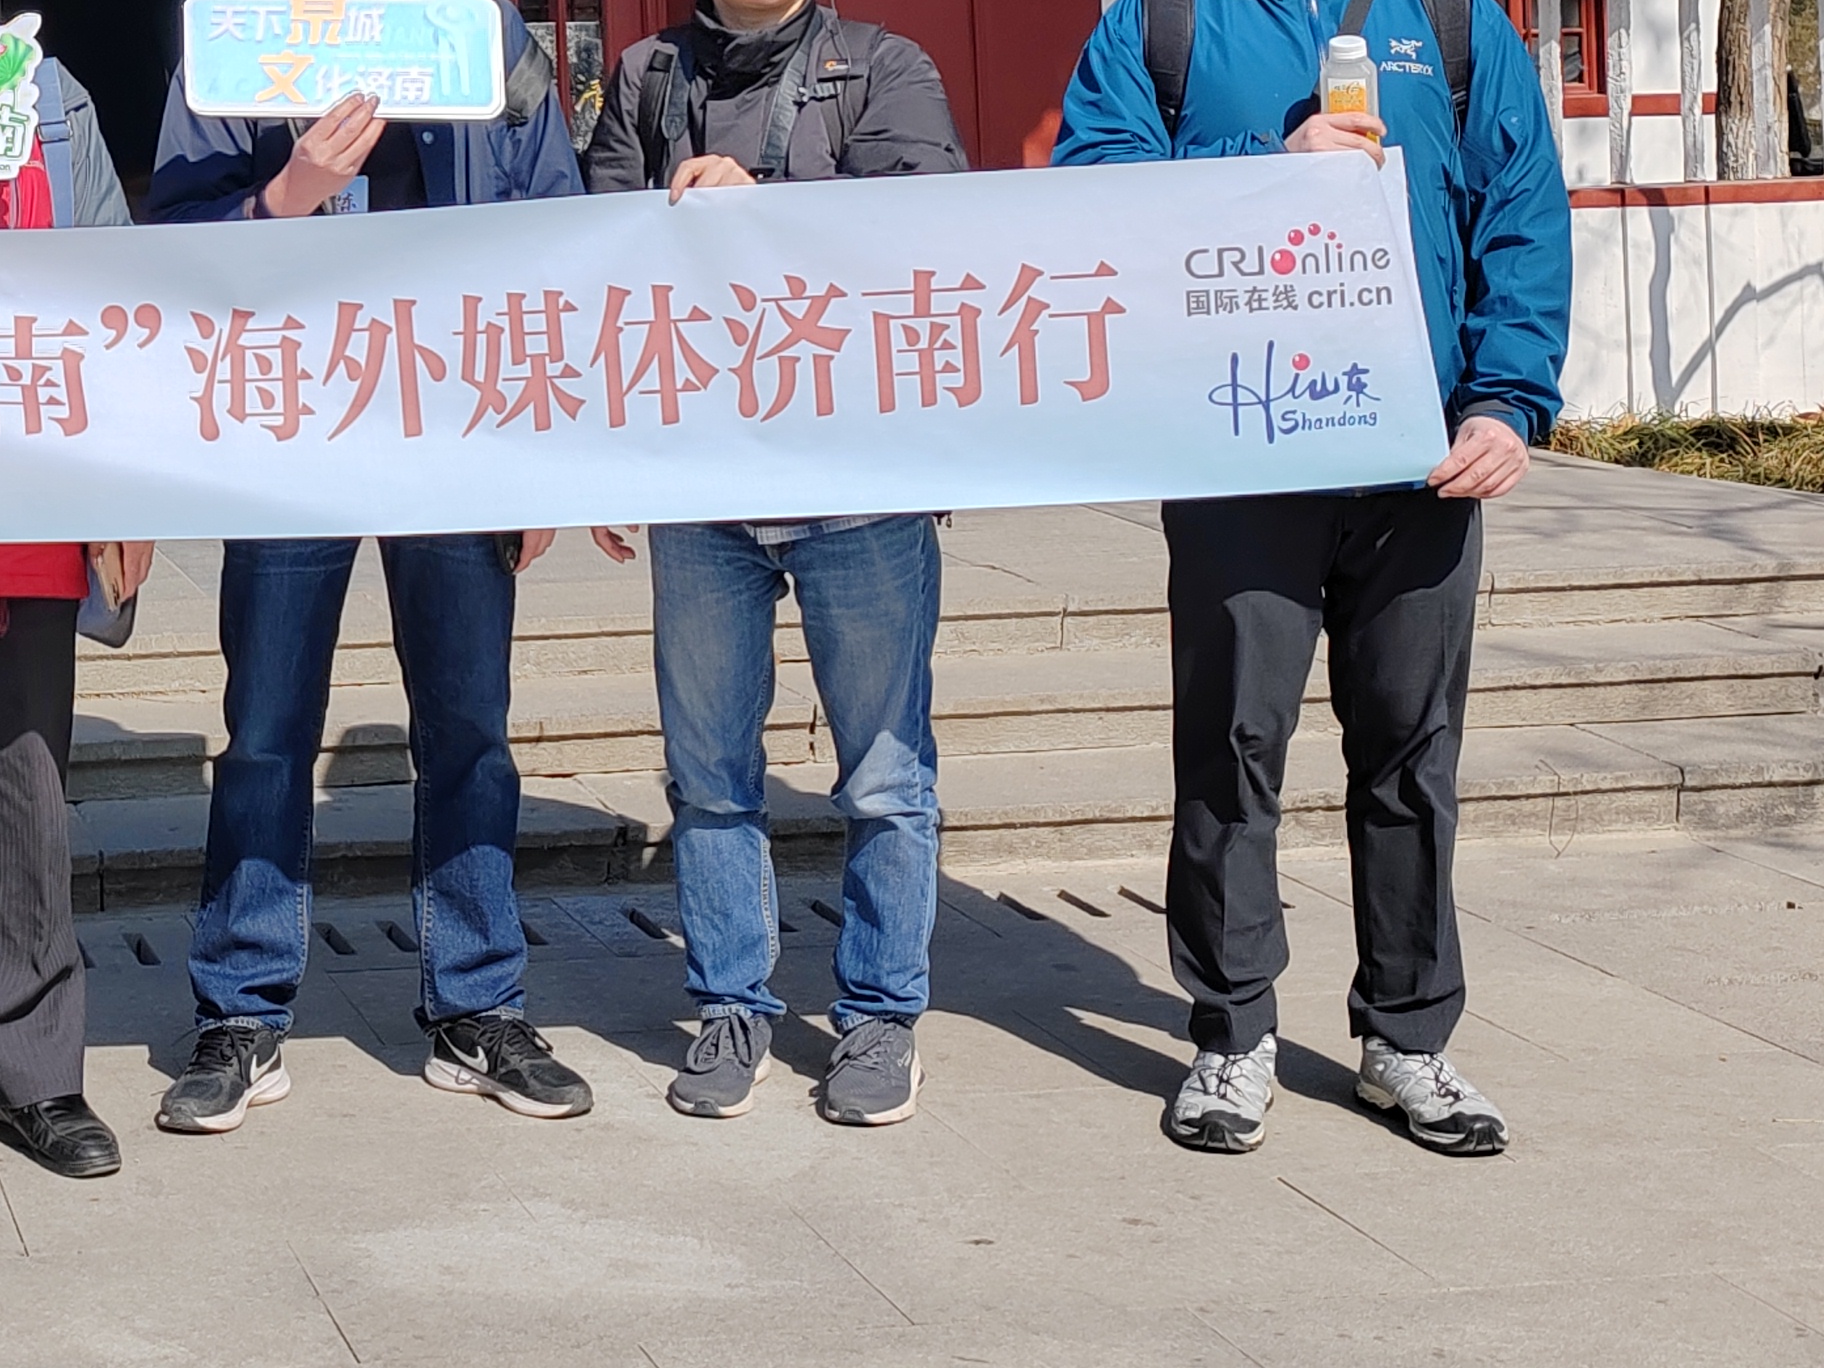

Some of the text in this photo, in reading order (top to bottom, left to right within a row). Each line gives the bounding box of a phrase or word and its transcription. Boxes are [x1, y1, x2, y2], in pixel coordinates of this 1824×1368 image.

[255, 49, 434, 105] 文化济南
[1186, 282, 1393, 317] 国际在线 cri.cn
[1277, 409, 1378, 435] Shandong
